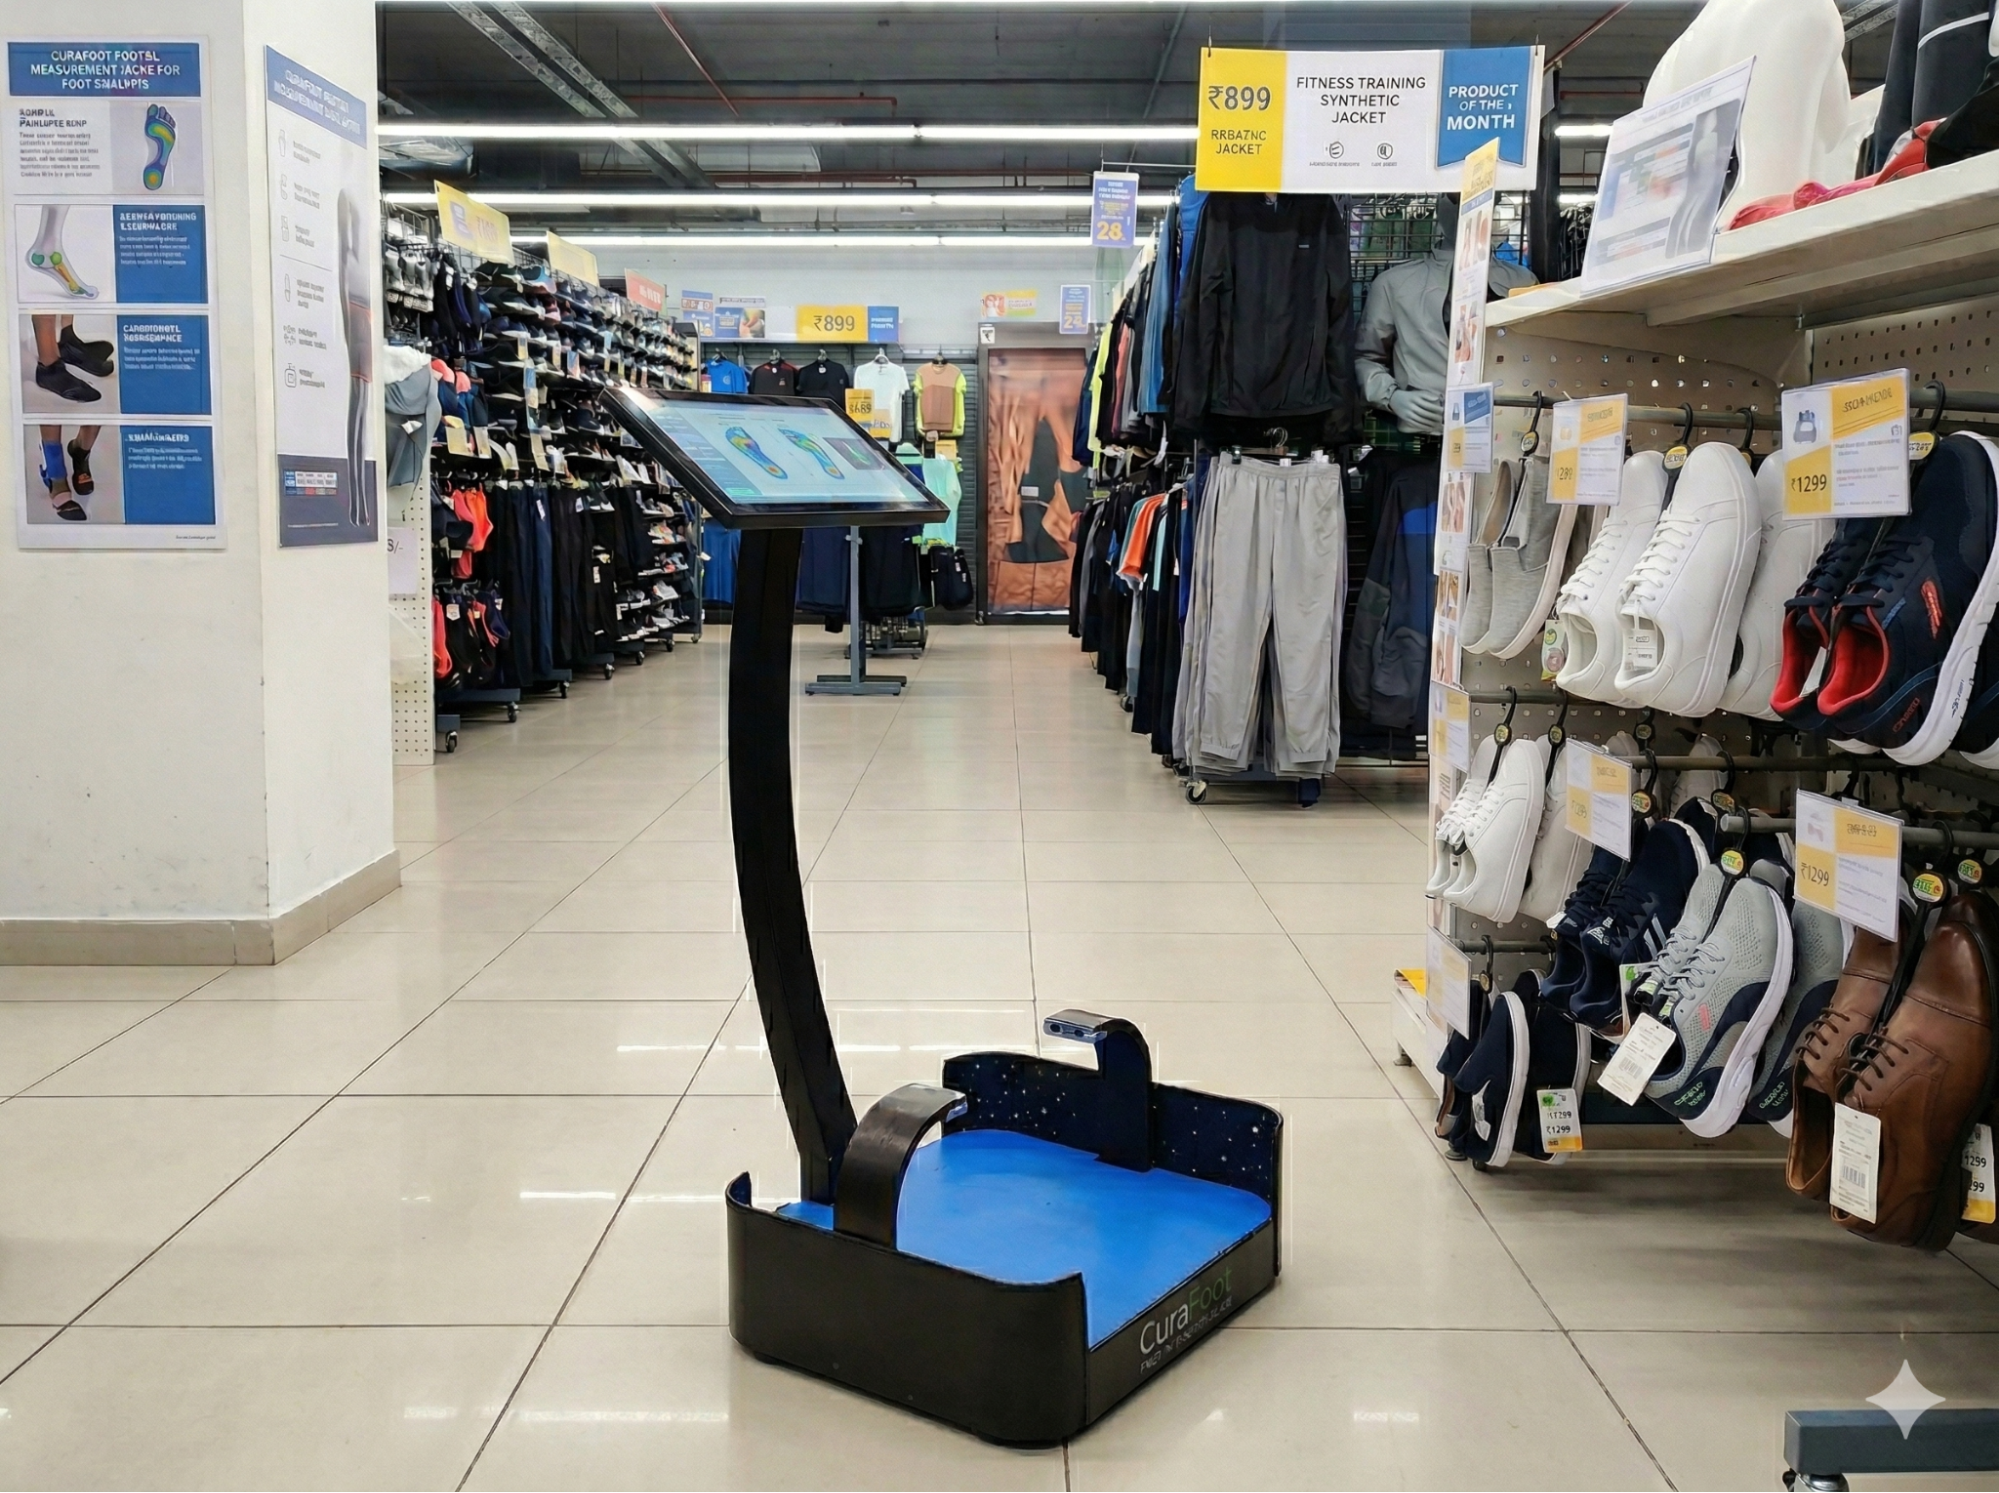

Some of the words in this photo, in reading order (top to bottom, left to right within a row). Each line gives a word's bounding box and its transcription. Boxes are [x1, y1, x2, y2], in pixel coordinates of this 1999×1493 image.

[51, 50, 112, 62] CURAFOOT
[31, 64, 117, 76] MEASUREMENT
[157, 65, 181, 76] FOR
[61, 78, 92, 90] FOOT
[1296, 76, 1354, 90] FITNESS
[1358, 76, 1427, 90] TRAINING
[1448, 83, 1519, 98] PRODUCT
[1320, 94, 1400, 107] SYNTHETIC
[1459, 100, 1477, 112] OF
[1479, 99, 1505, 111] THE
[1331, 111, 1387, 124] JACKET
[1446, 113, 1516, 131] MONTH
[1215, 142, 1263, 155] JACKET
[813, 315, 856, 332] ₹899
[1800, 861, 1830, 887] ₹1299
[1140, 1266, 1232, 1355] CuraFoot
